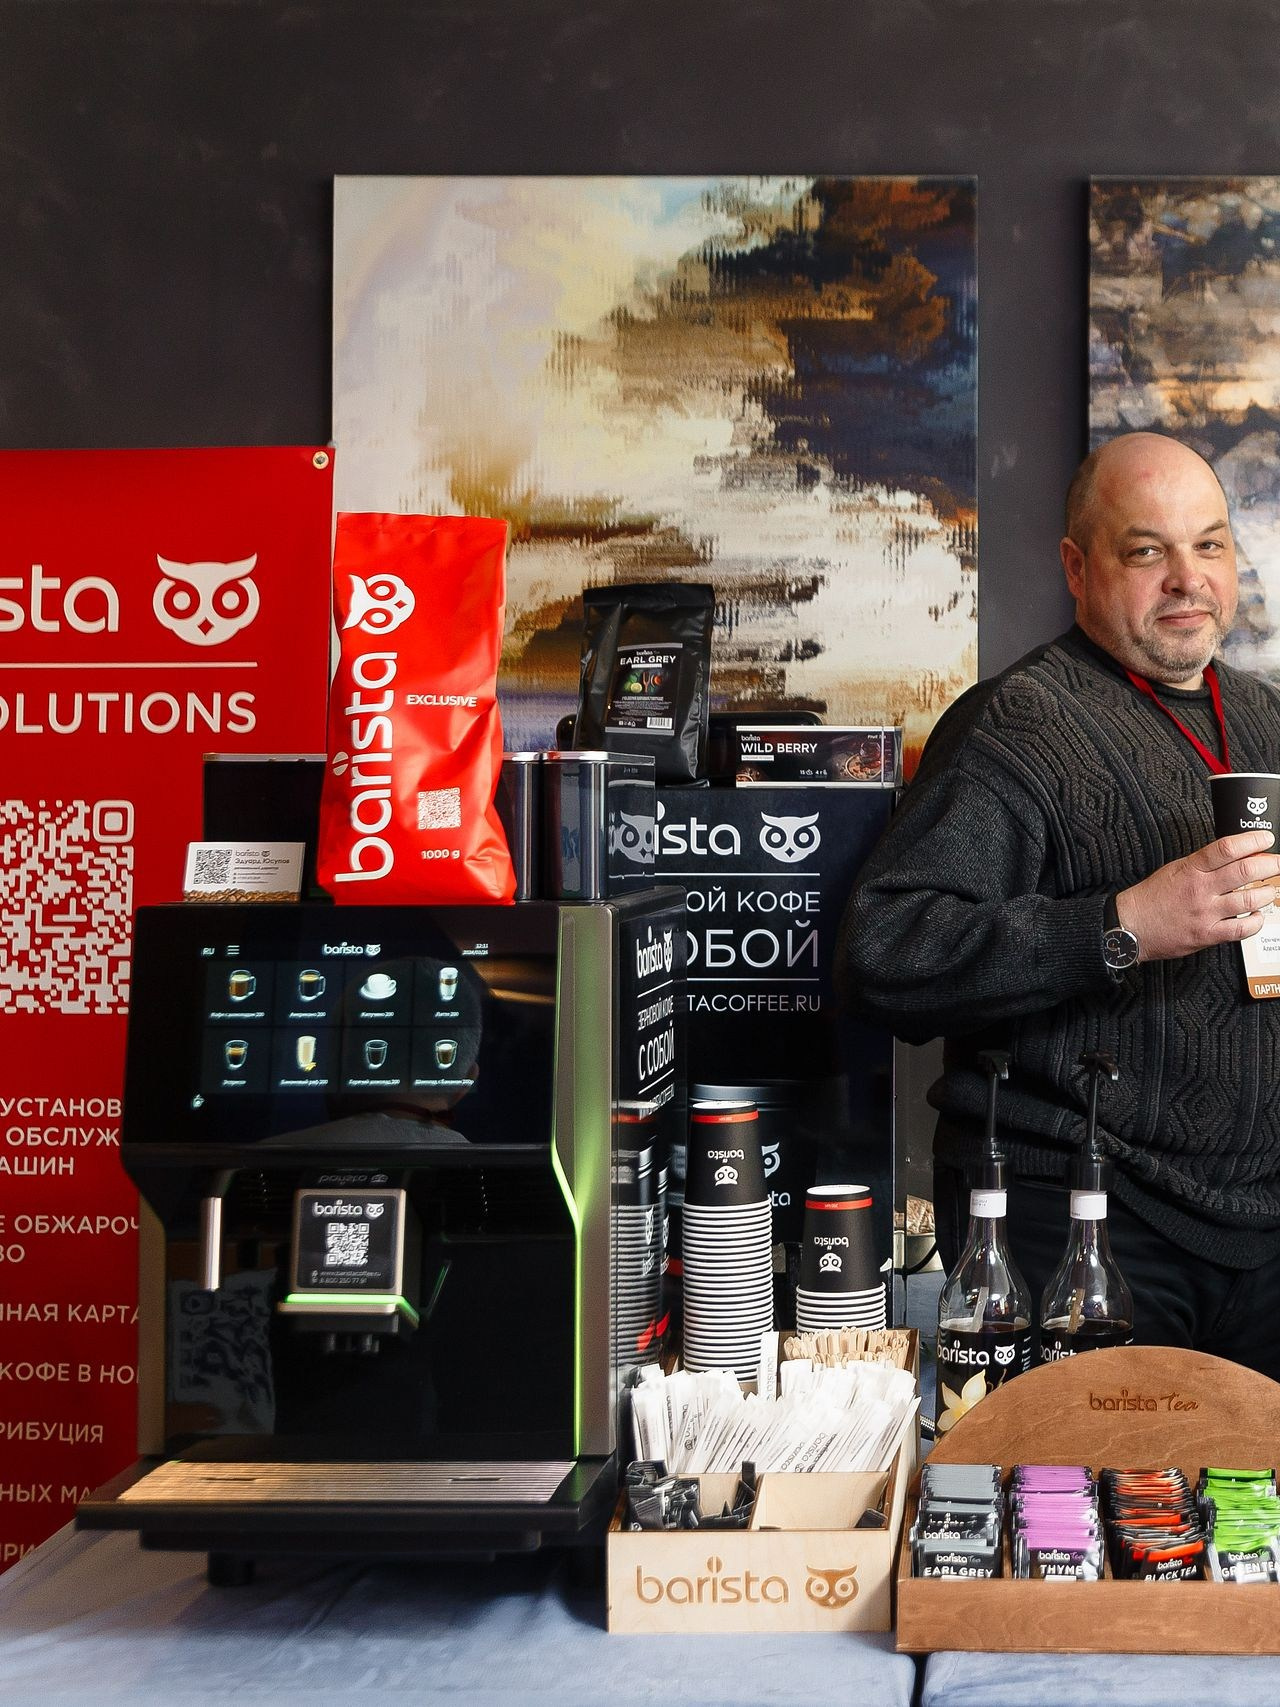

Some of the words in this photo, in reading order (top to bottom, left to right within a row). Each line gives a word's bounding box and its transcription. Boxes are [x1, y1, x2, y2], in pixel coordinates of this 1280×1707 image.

[620, 656, 645, 665] EARL
[648, 655, 676, 664] GREY
[407, 694, 477, 708] EXCLUSIVE
[0, 691, 256, 734] LUTIONS
[741, 743, 773, 753] WILD
[777, 743, 818, 753] BERRY
[333, 651, 399, 882] barista
[1240, 817, 1273, 829] barista
[421, 849, 448, 860] 1000
[452, 850, 461, 862] g
[738, 890, 820, 914] КОФЕ
[324, 942, 364, 955] barista
[636, 926, 663, 978] barista
[687, 995, 820, 1012] TACOFFEE.RU
[638, 1044, 646, 1080] С
[647, 1020, 675, 1075] СОБОЙ
[0, 1098, 122, 1118] УСТАНОВ
[6, 1126, 120, 1146] ОБСЛУЖ
[708, 1149, 744, 1164] barista
[314, 1199, 363, 1216] barista
[814, 1236, 849, 1250] barista
[0, 1303, 59, 1322] НАЯ
[937, 1340, 990, 1366] barista
[78, 1364, 91, 1382] В
[100, 1365, 139, 1384] НО
[1089, 1389, 1158, 1411] barista
[1160, 1391, 1199, 1411] Tea
[924, 1529, 960, 1539] barista
[937, 1552, 967, 1563] barista
[1039, 1549, 1070, 1560] barista
[1229, 1550, 1258, 1560] barista
[1040, 1565, 1083, 1575] THYME
[1157, 1558, 1182, 1570] barista
[1221, 1563, 1260, 1577] GREN
[923, 1566, 957, 1577] EARL
[959, 1567, 993, 1578] GREY
[1145, 1569, 1178, 1581] BLACK
[1180, 1565, 1197, 1578] TEA
[637, 1556, 789, 1604] barista
